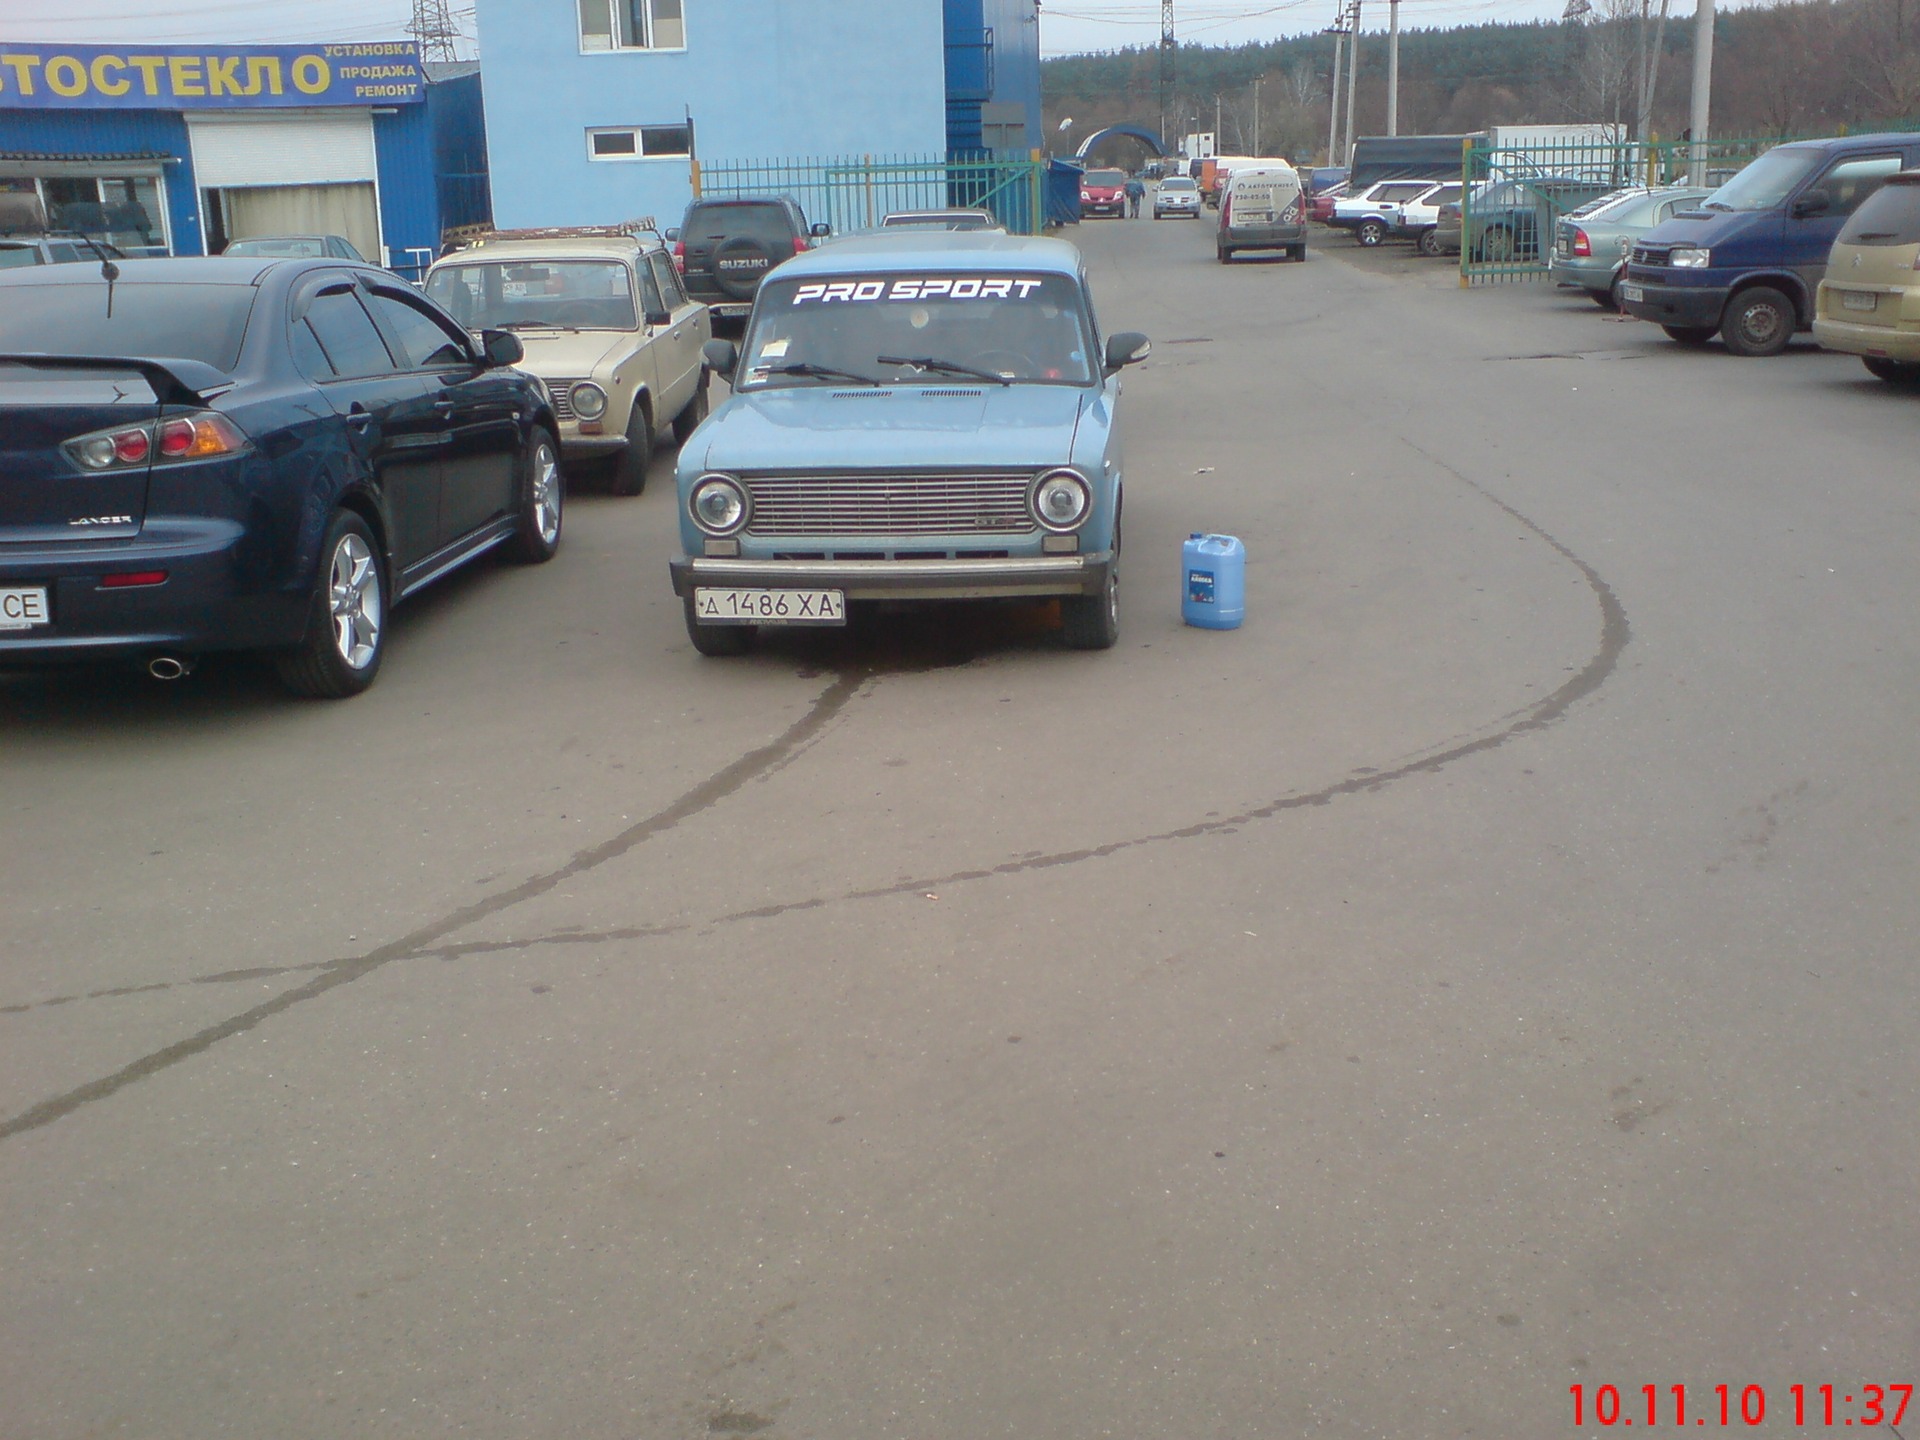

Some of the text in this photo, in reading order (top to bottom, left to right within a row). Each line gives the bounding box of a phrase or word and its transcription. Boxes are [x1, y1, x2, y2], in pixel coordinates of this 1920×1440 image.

[323, 43, 415, 57] УСТАНОВКА
[0, 54, 331, 97] ТОСТЕКЛО
[340, 65, 416, 79] ПРОДАЖА
[355, 84, 417, 97] РЕМОНТ
[719, 258, 769, 270] SUZUKI
[792, 279, 1042, 305] PRO SPORT
[726, 592, 790, 616] 1486
